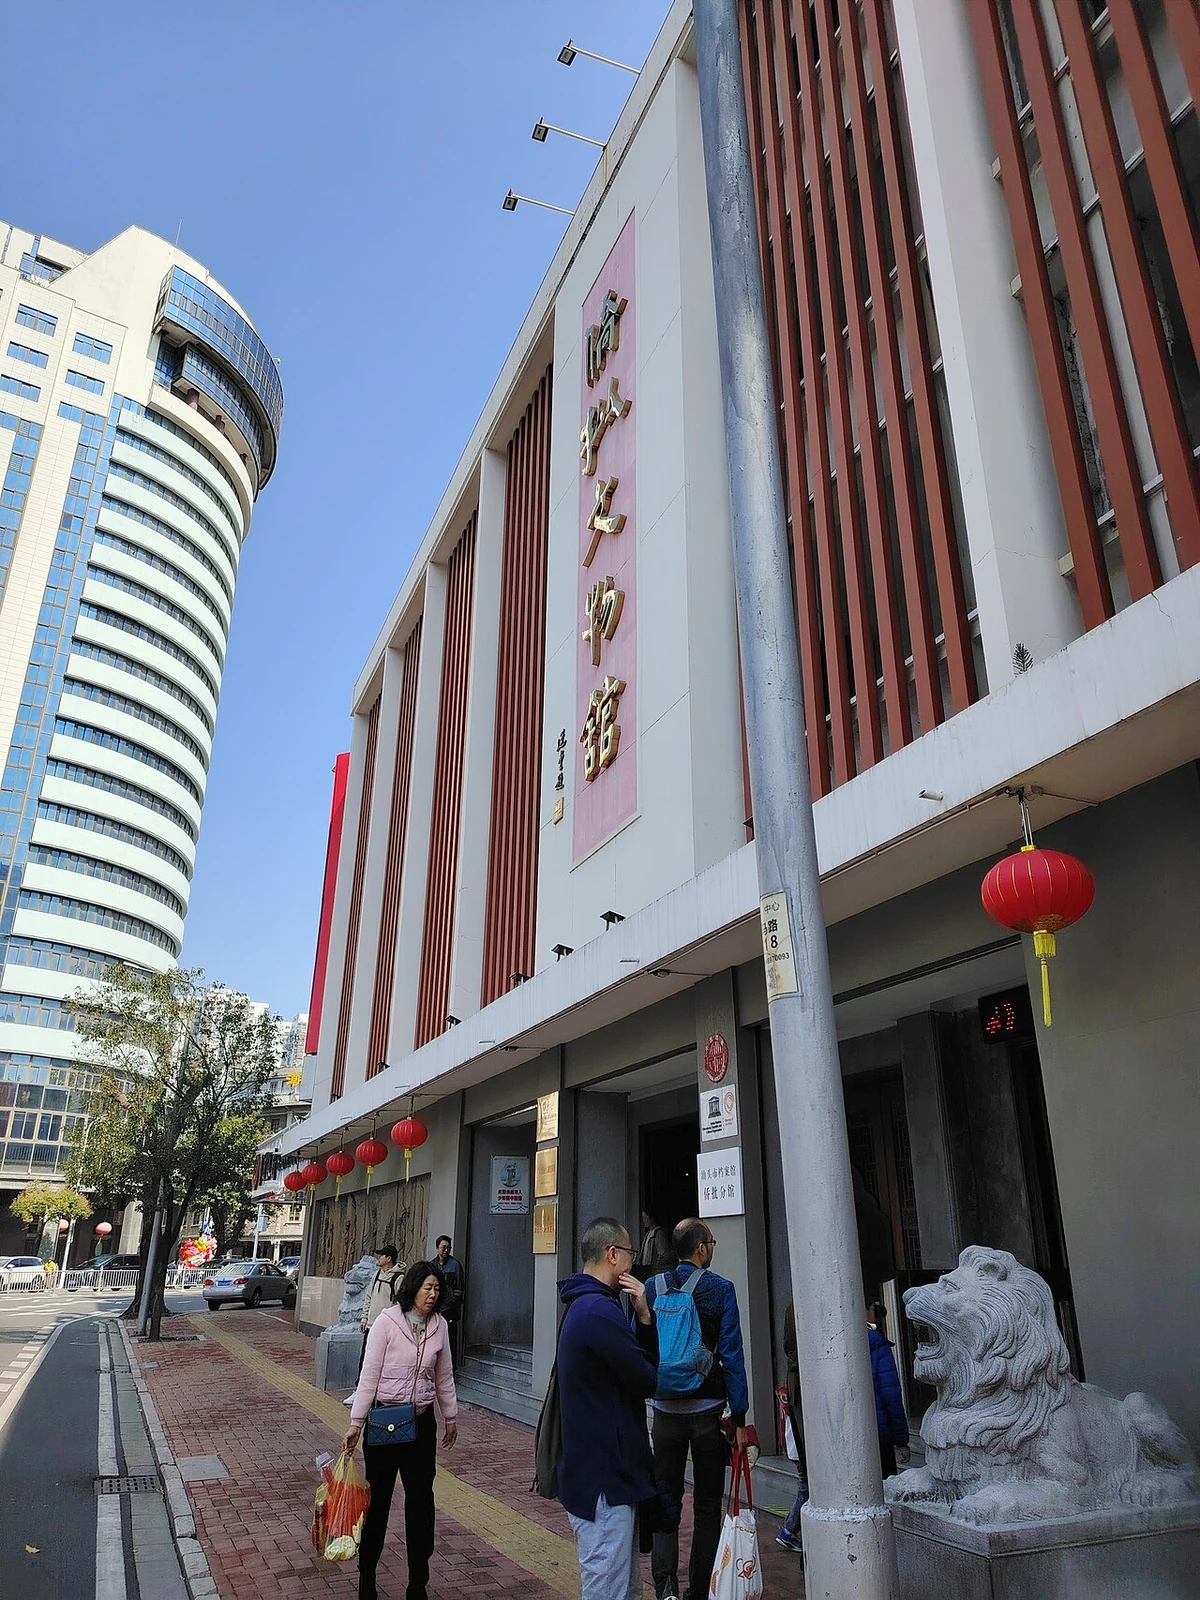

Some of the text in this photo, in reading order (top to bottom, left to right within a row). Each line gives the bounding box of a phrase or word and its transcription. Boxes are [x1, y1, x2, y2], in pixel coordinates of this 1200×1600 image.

[700, 1164, 736, 1181] 汕头市档案馆
[703, 1183, 735, 1201] 侨批分馆
